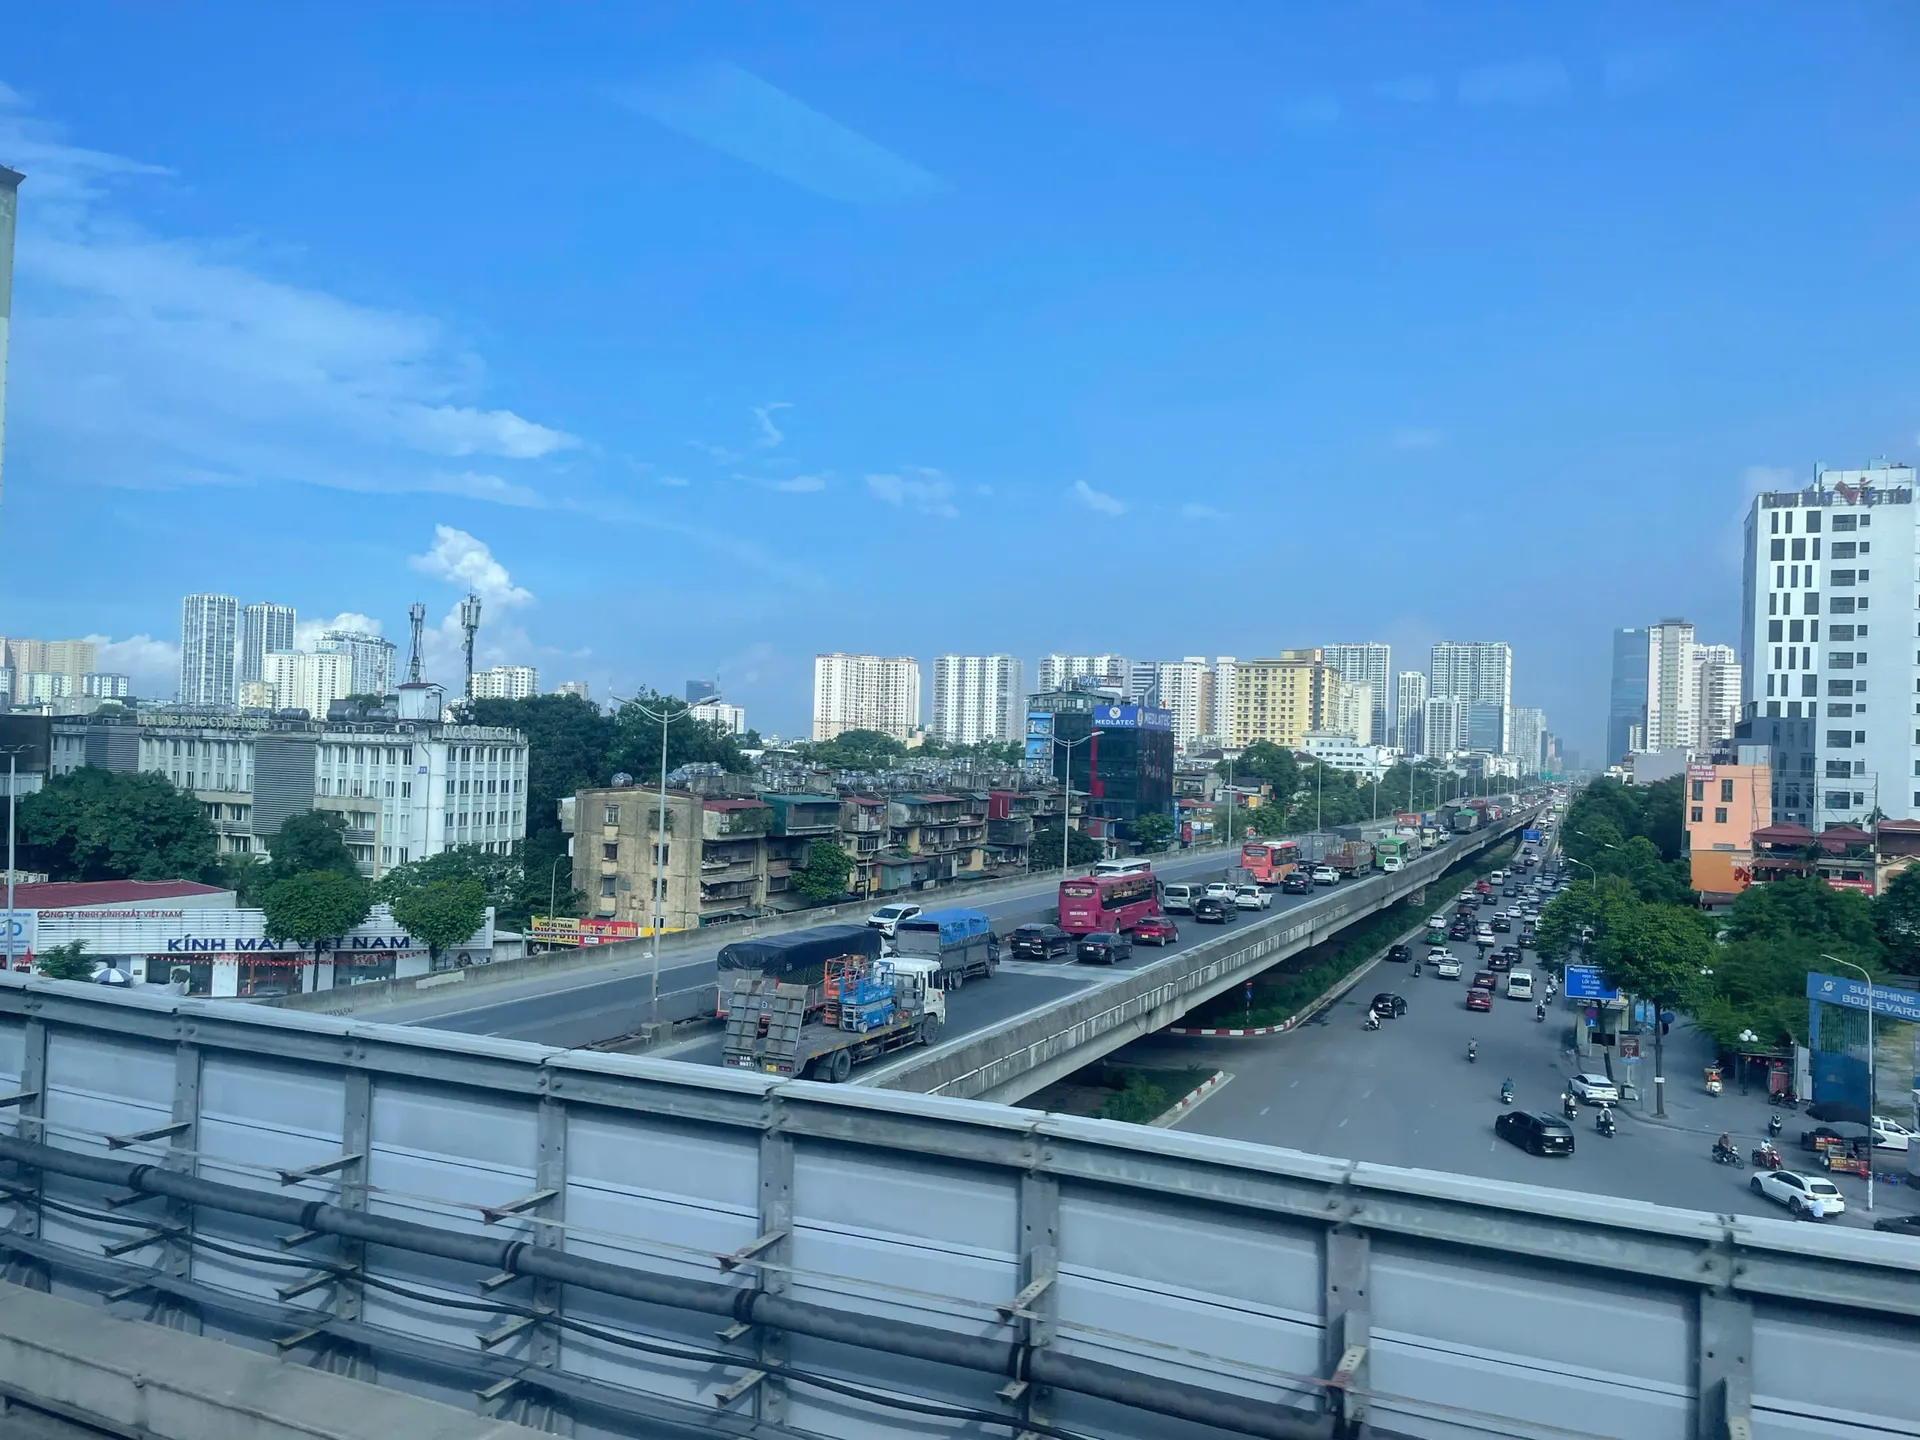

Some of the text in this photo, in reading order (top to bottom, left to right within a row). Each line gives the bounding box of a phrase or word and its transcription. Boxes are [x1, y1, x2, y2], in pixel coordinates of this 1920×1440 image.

[37, 910, 64, 919] CÔNG
[78, 911, 99, 919] TNHH
[101, 909, 122, 919] KÍNH
[162, 910, 182, 918] NAM
[167, 933, 226, 951] KÍNH
[352, 936, 410, 950] NAM
[1849, 985, 1915, 1005] SUNSHINE
